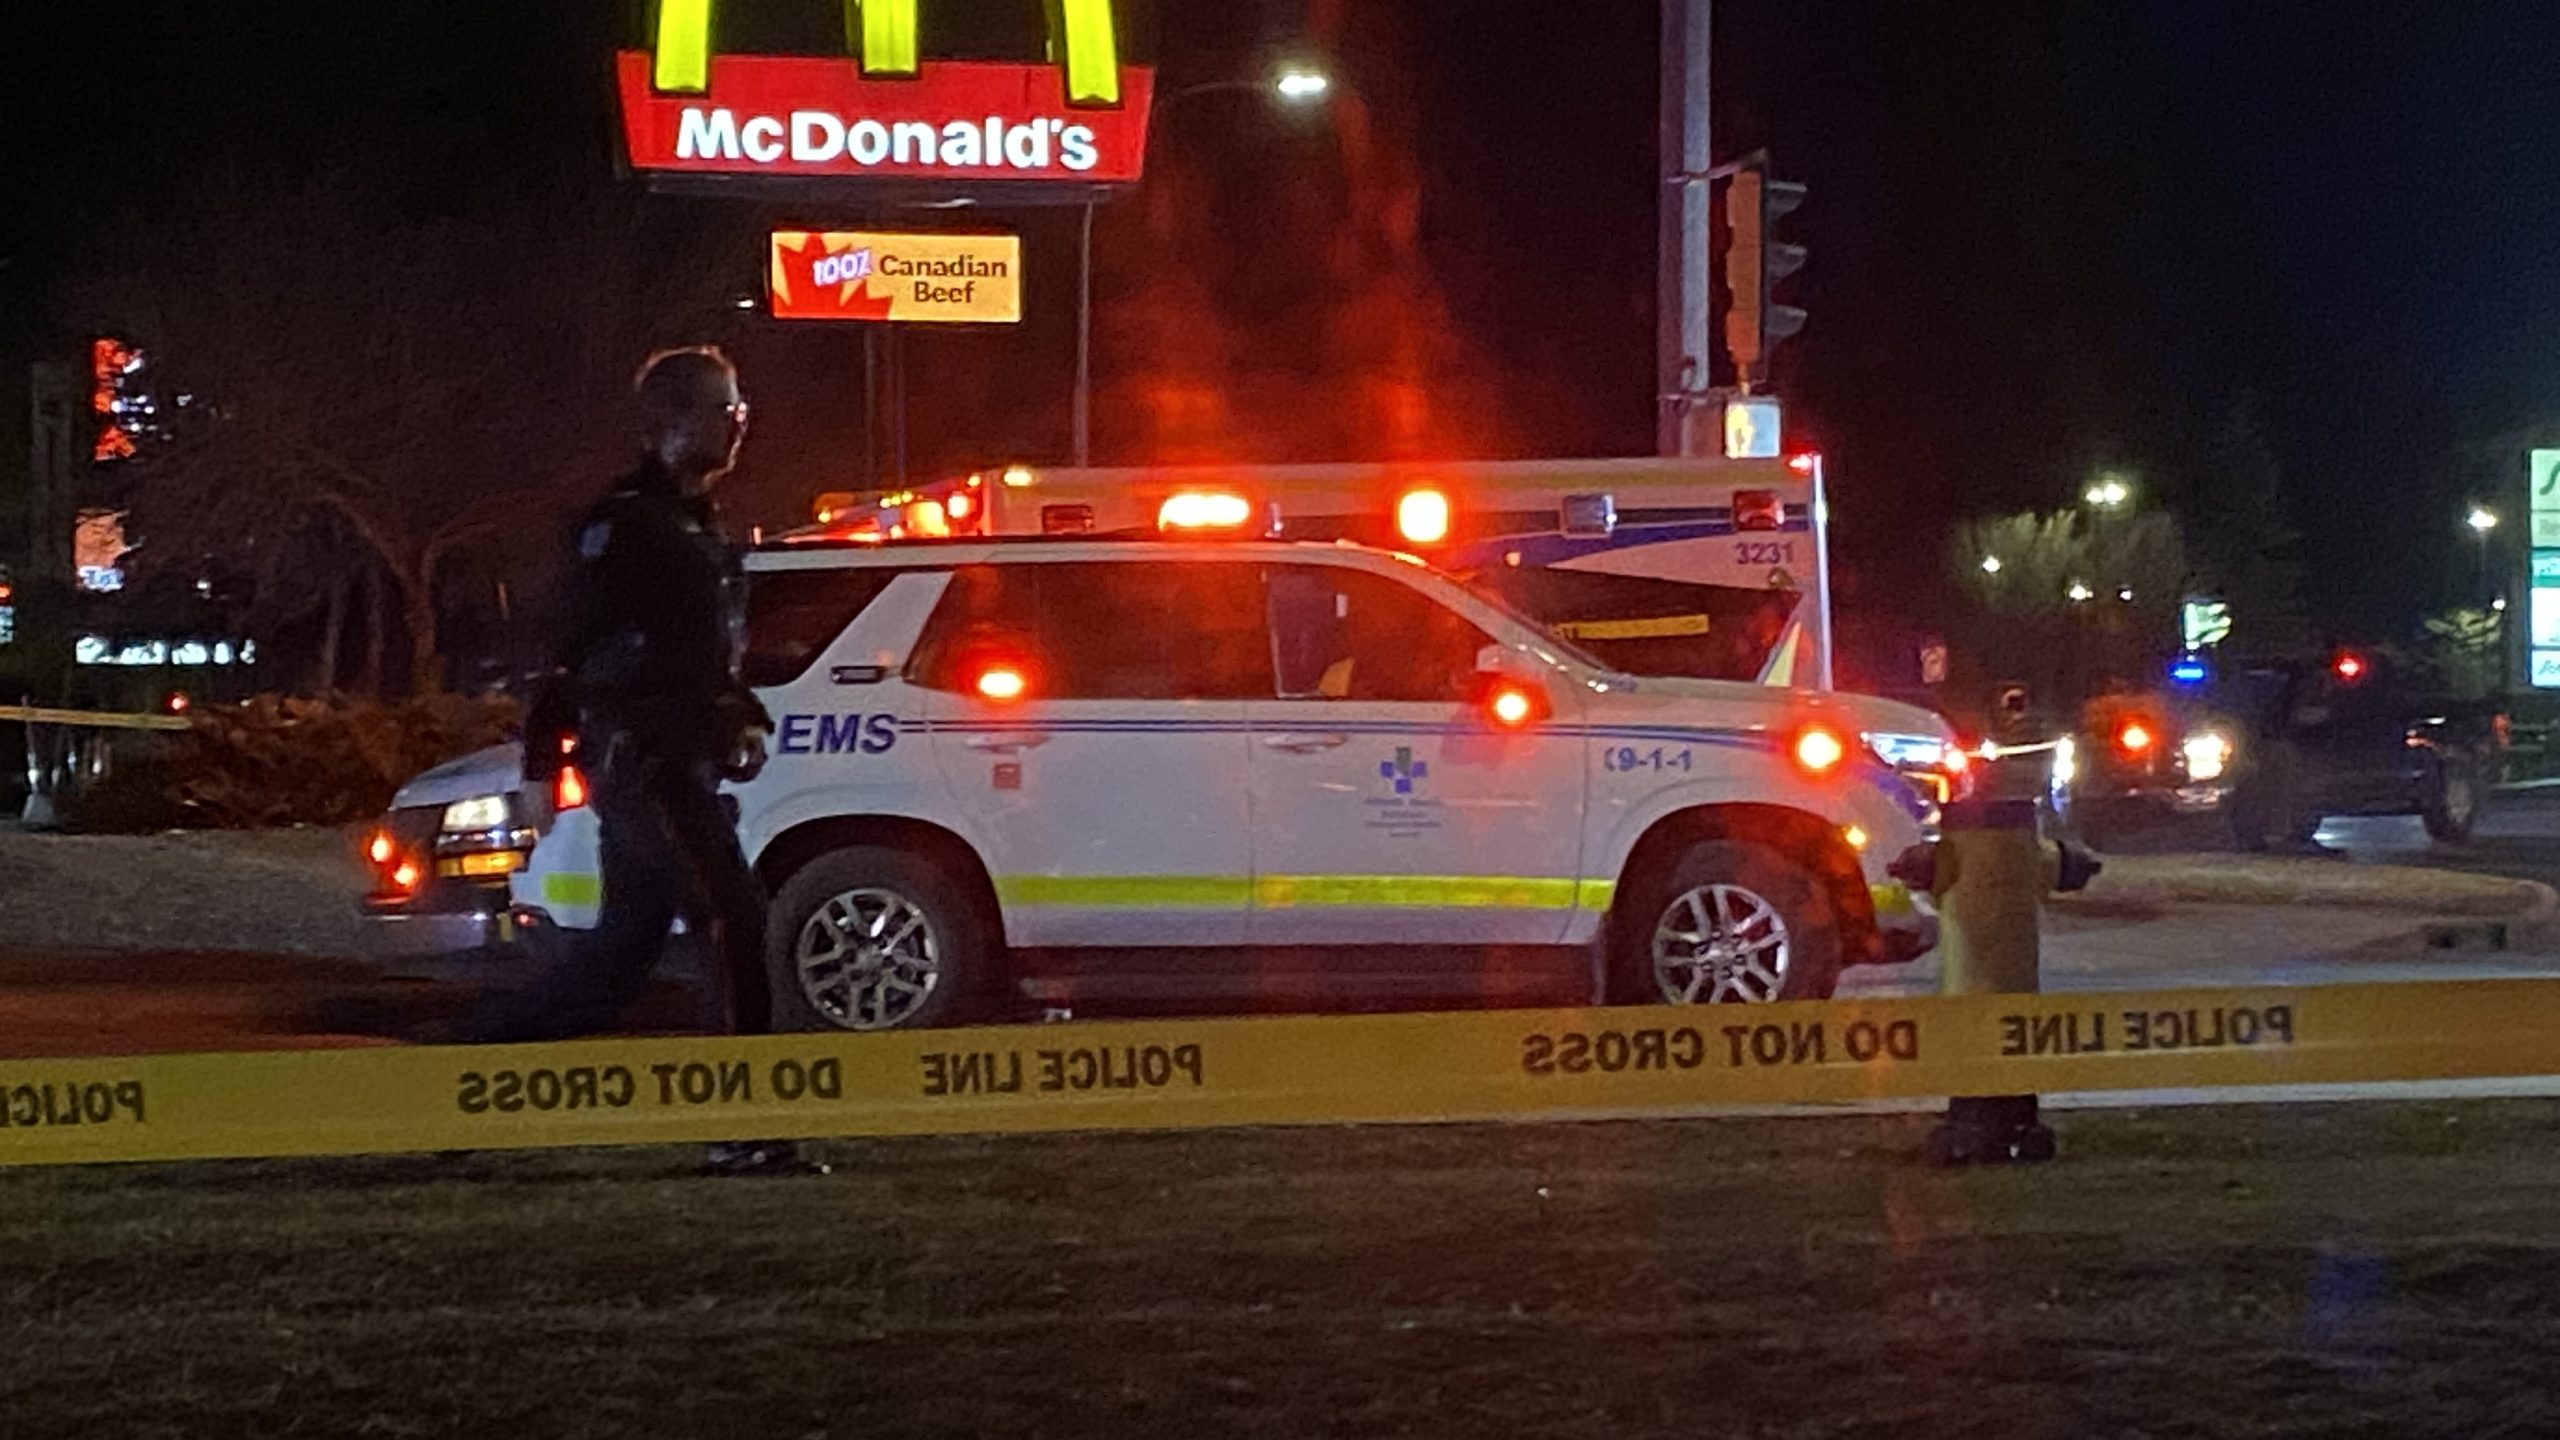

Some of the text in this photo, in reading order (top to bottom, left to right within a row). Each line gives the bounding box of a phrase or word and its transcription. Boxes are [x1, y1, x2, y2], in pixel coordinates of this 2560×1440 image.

[675, 107, 1099, 171] McDonald's
[813, 249, 870, 286] 100%
[879, 253, 1008, 279] Canadian
[914, 281, 975, 304] Beef
[1735, 542, 1794, 565] 3231
[777, 713, 899, 754] EMS
